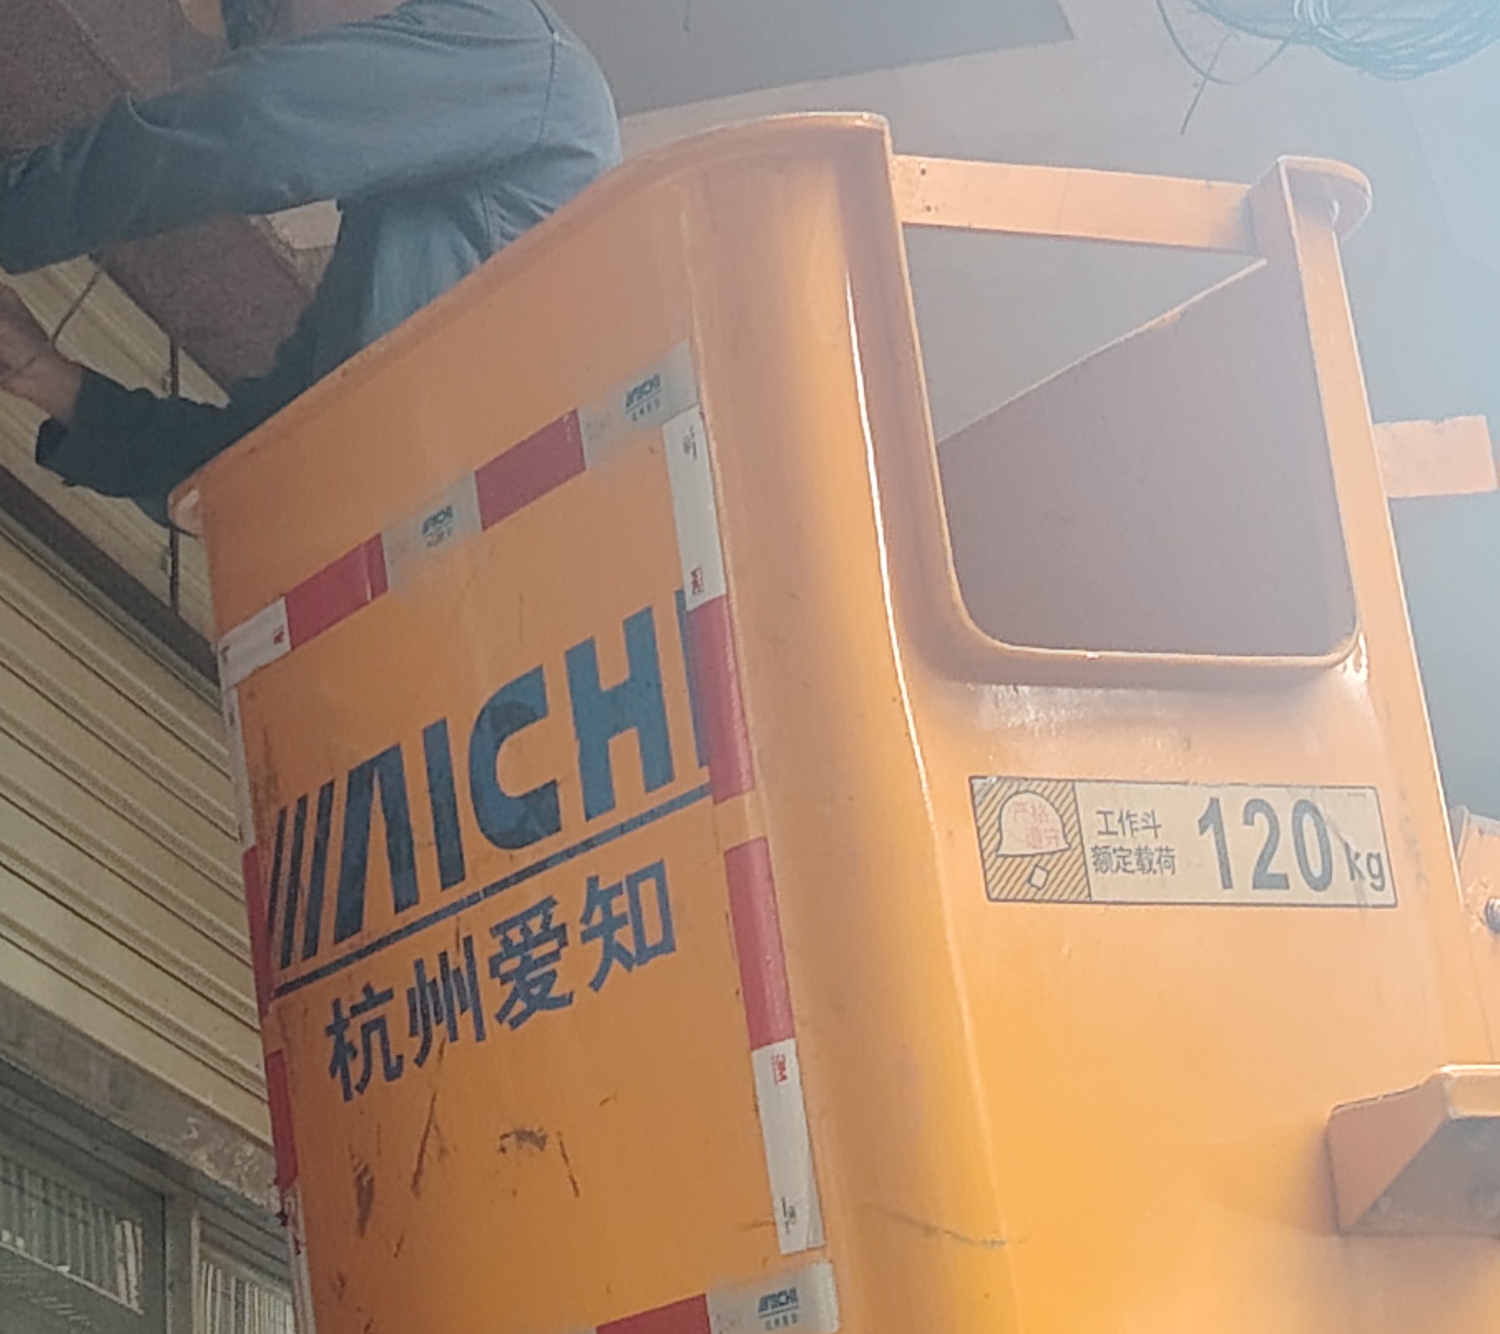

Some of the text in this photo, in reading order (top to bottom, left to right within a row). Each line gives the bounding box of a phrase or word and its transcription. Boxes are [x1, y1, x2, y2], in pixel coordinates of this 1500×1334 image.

[1095, 809, 1163, 840] 工作斗
[1090, 845, 1177, 876] 额定载荷
[324, 859, 678, 1102] 杭州爱知
